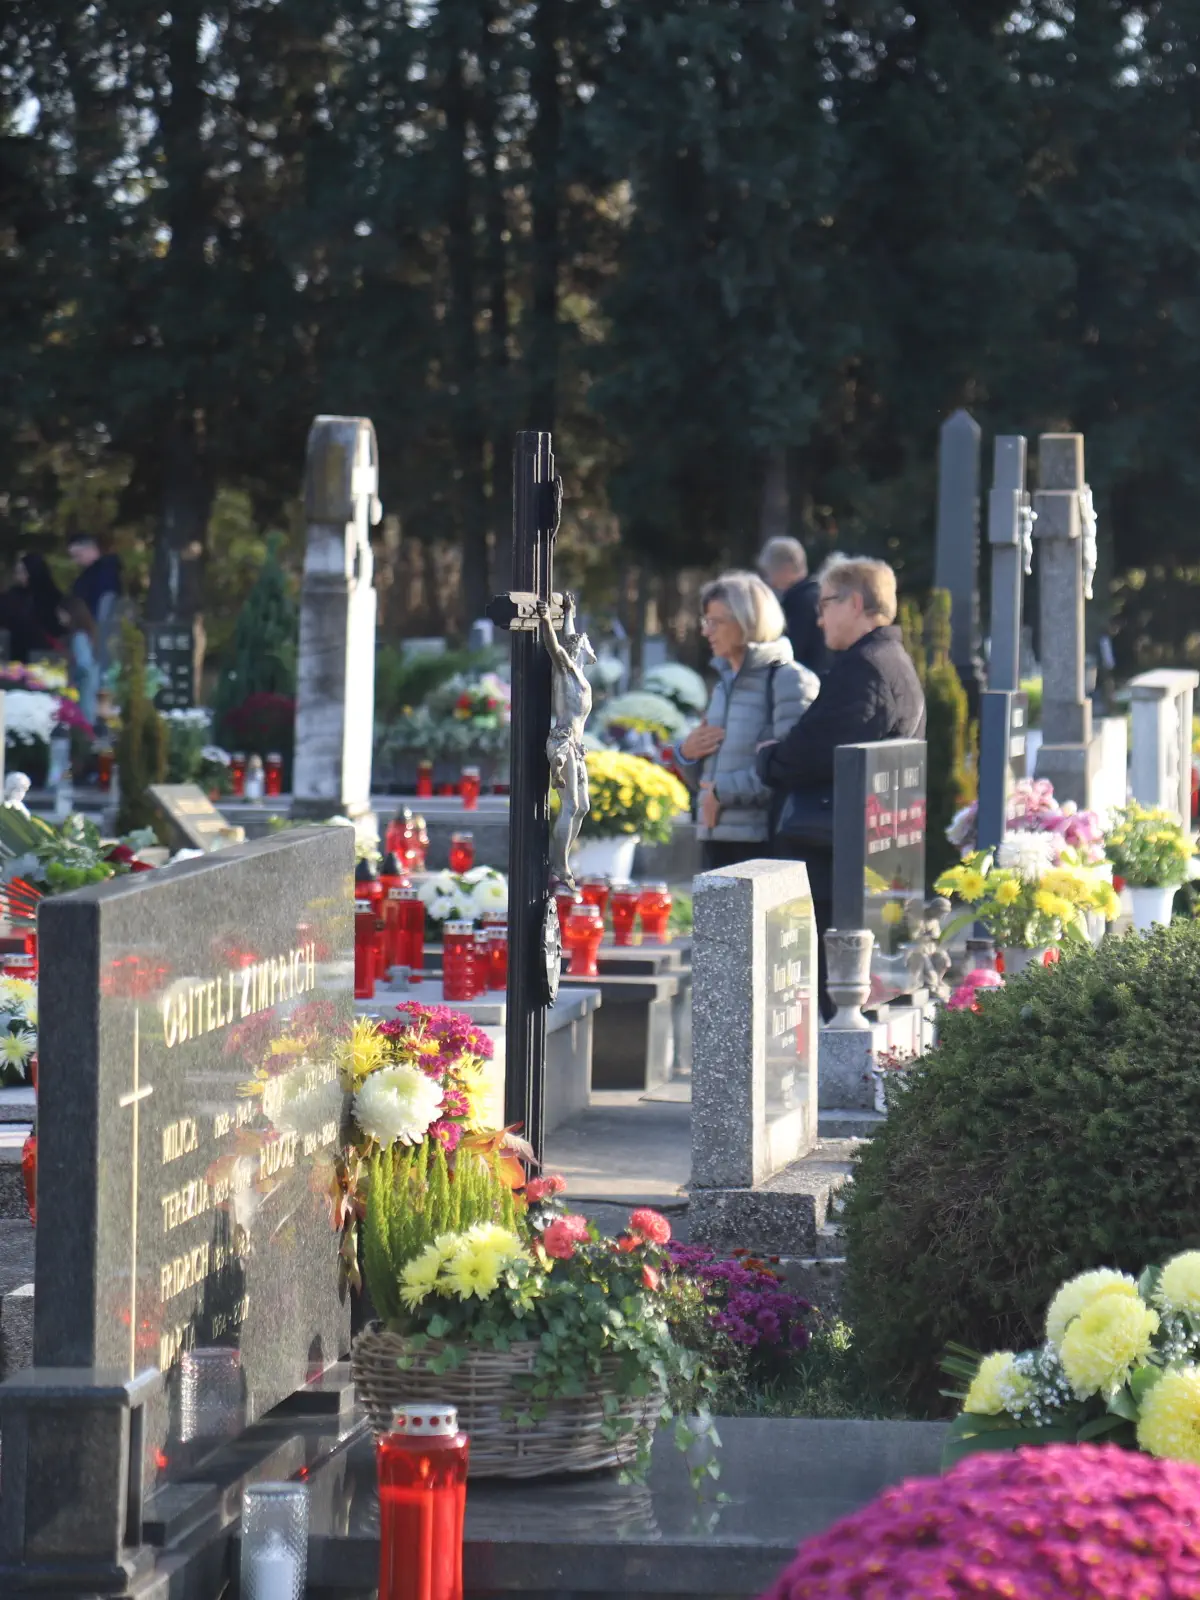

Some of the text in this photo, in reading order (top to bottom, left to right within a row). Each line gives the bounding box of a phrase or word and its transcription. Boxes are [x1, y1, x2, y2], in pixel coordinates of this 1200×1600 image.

[163, 940, 315, 1049] OBITELJ ZIMPRICH
[260, 1131, 297, 1180] RUDOLF
[161, 1241, 209, 1303] FRIDRICH
